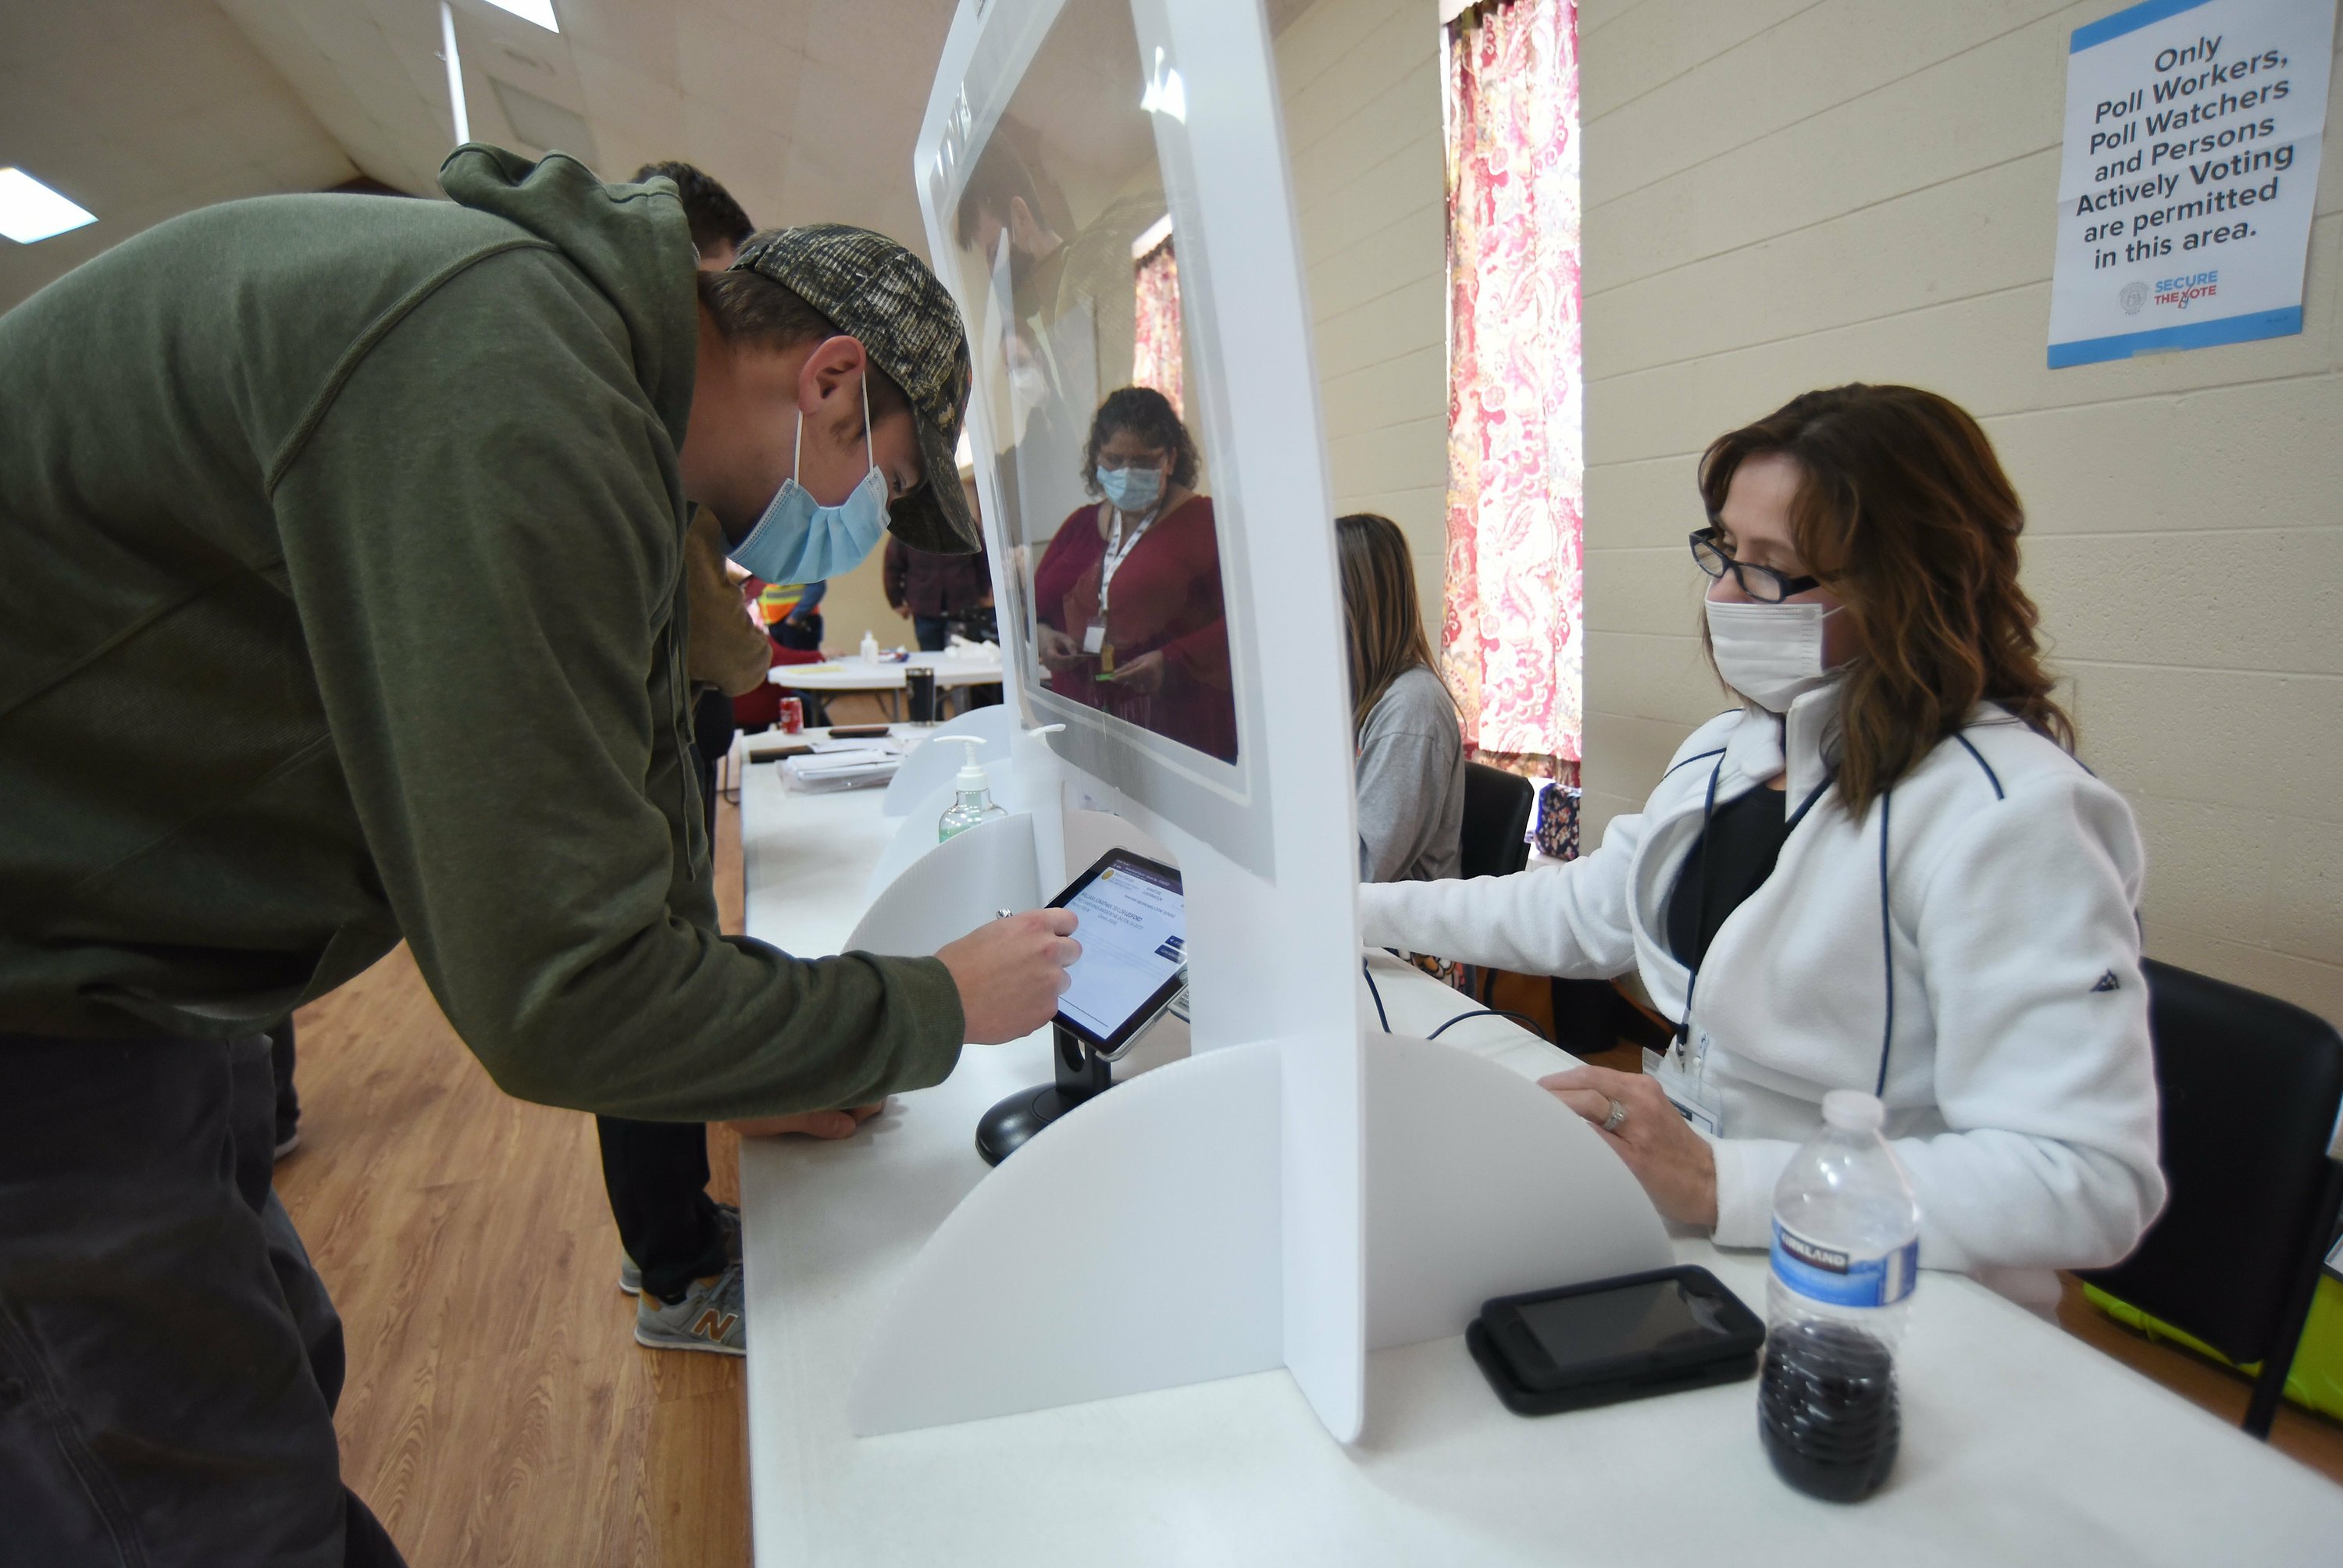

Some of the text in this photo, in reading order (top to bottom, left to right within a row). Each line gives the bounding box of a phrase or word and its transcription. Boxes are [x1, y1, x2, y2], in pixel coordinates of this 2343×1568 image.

[2154, 35, 2223, 73] Only
[2095, 48, 2288, 124] Poll Workers,
[2089, 79, 2290, 155] Poll Watchers
[2095, 117, 2275, 182] and Persons
[2076, 144, 2294, 216] Actively Voting
[2084, 176, 2278, 243] are permitted
[2095, 222, 2256, 269] in this area.
[2154, 292, 2179, 305] THE
[2155, 270, 2218, 293] SECURE
[690, 1307, 738, 1342] N
